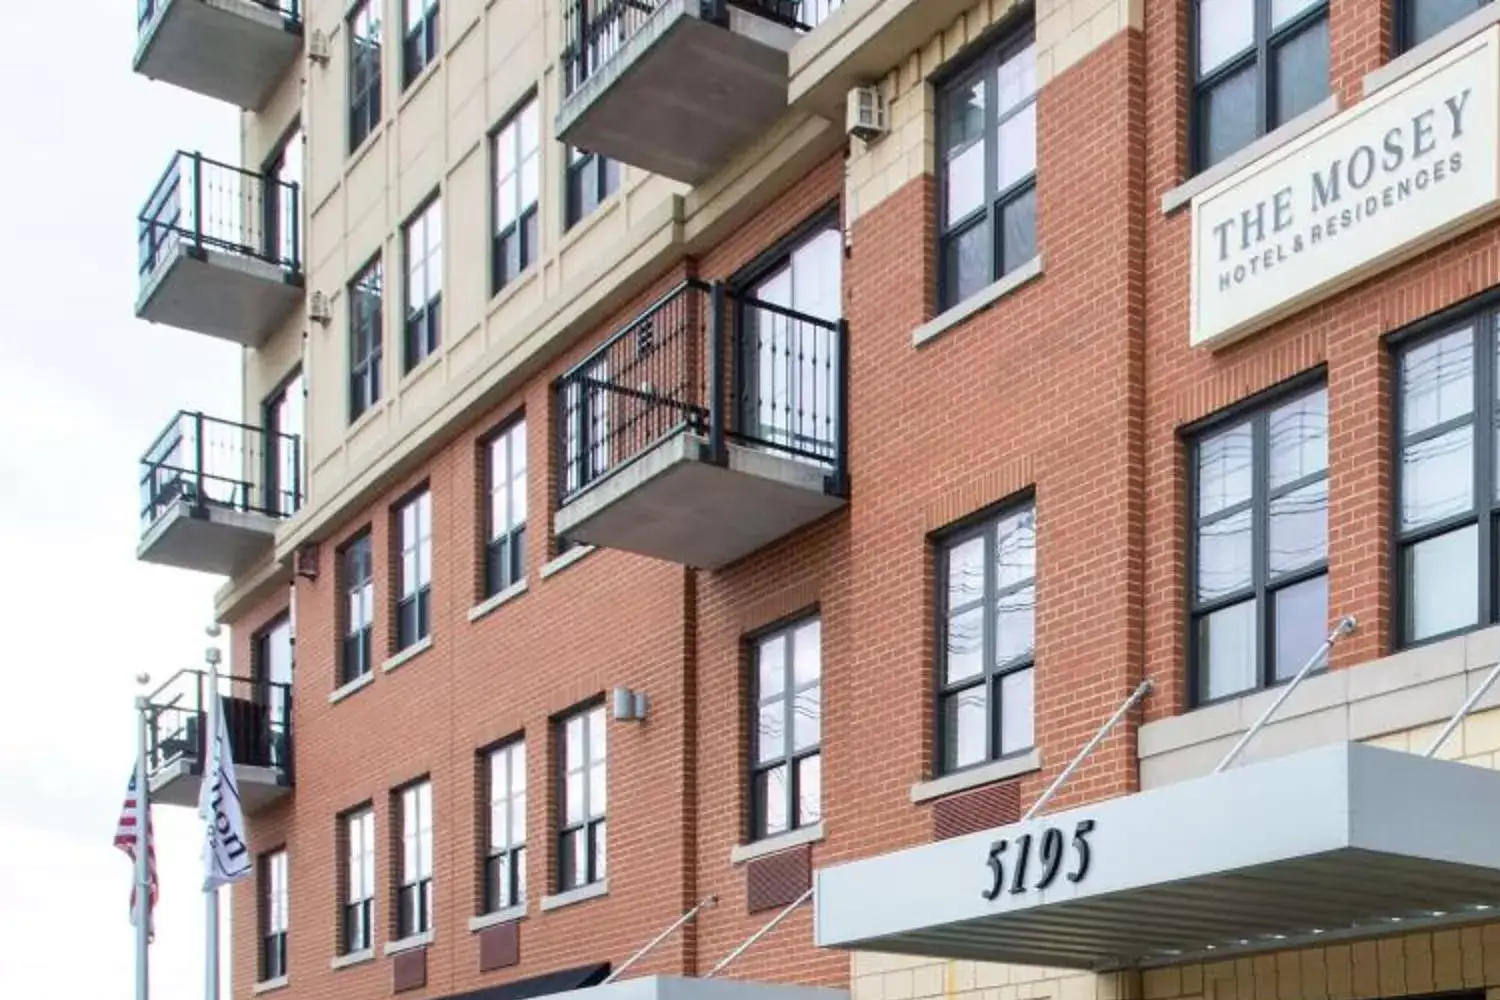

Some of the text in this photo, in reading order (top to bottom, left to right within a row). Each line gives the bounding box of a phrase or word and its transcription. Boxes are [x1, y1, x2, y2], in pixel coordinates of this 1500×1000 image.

[1212, 89, 1472, 261] THE MOSEY
[1218, 151, 1464, 292] HOTEL & RESIDENCES
[980, 819, 1097, 901] 5195
